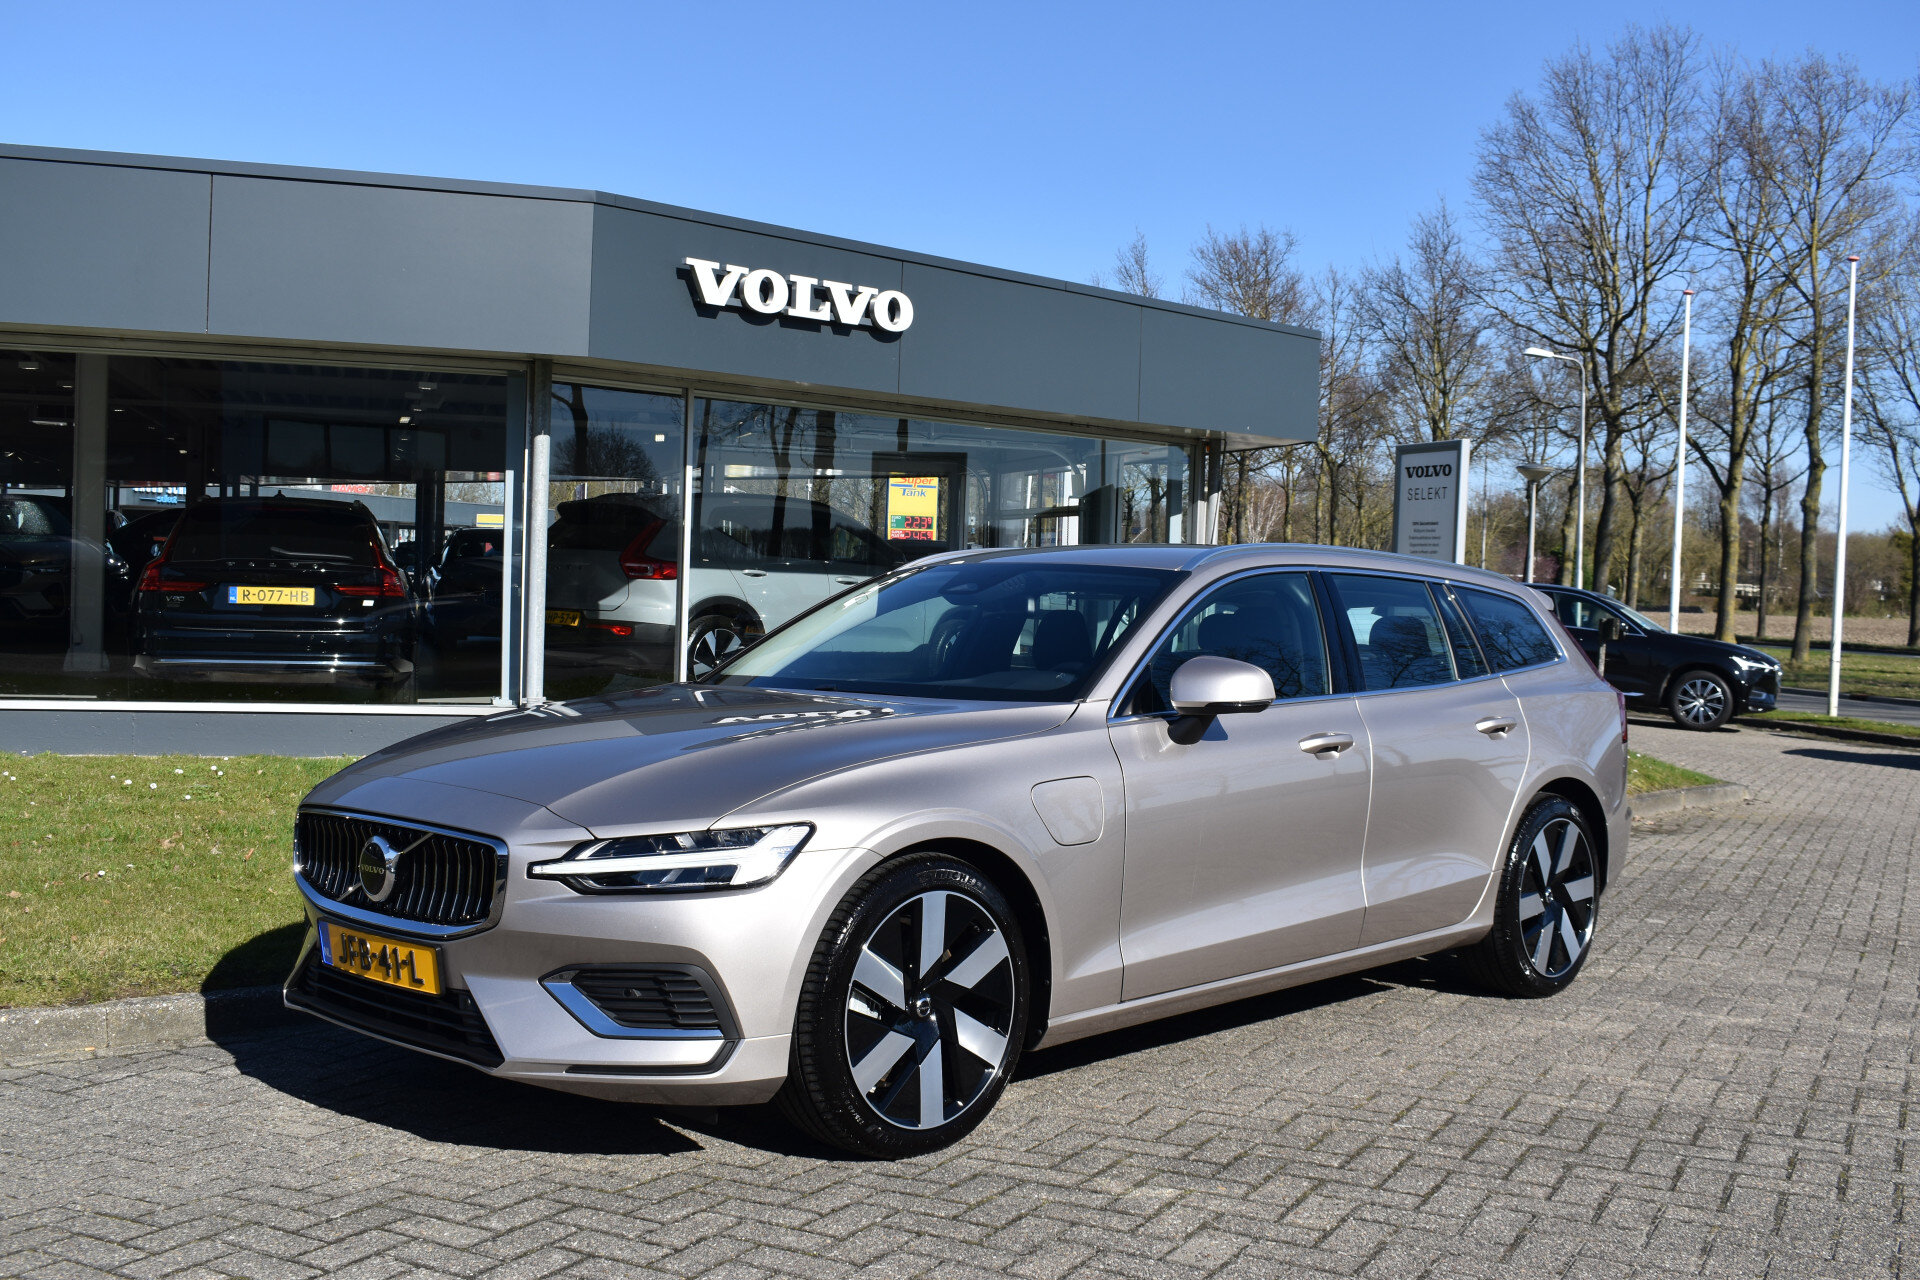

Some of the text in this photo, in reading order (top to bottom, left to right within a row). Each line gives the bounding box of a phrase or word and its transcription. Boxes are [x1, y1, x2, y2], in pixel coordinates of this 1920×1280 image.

[684, 257, 914, 332] VOLVO
[1405, 464, 1452, 478] VOLVO
[900, 487, 927, 497] Tank
[1407, 487, 1448, 500] SELEKT
[242, 589, 310, 603] R-077-HB
[360, 863, 385, 875] VOLVO
